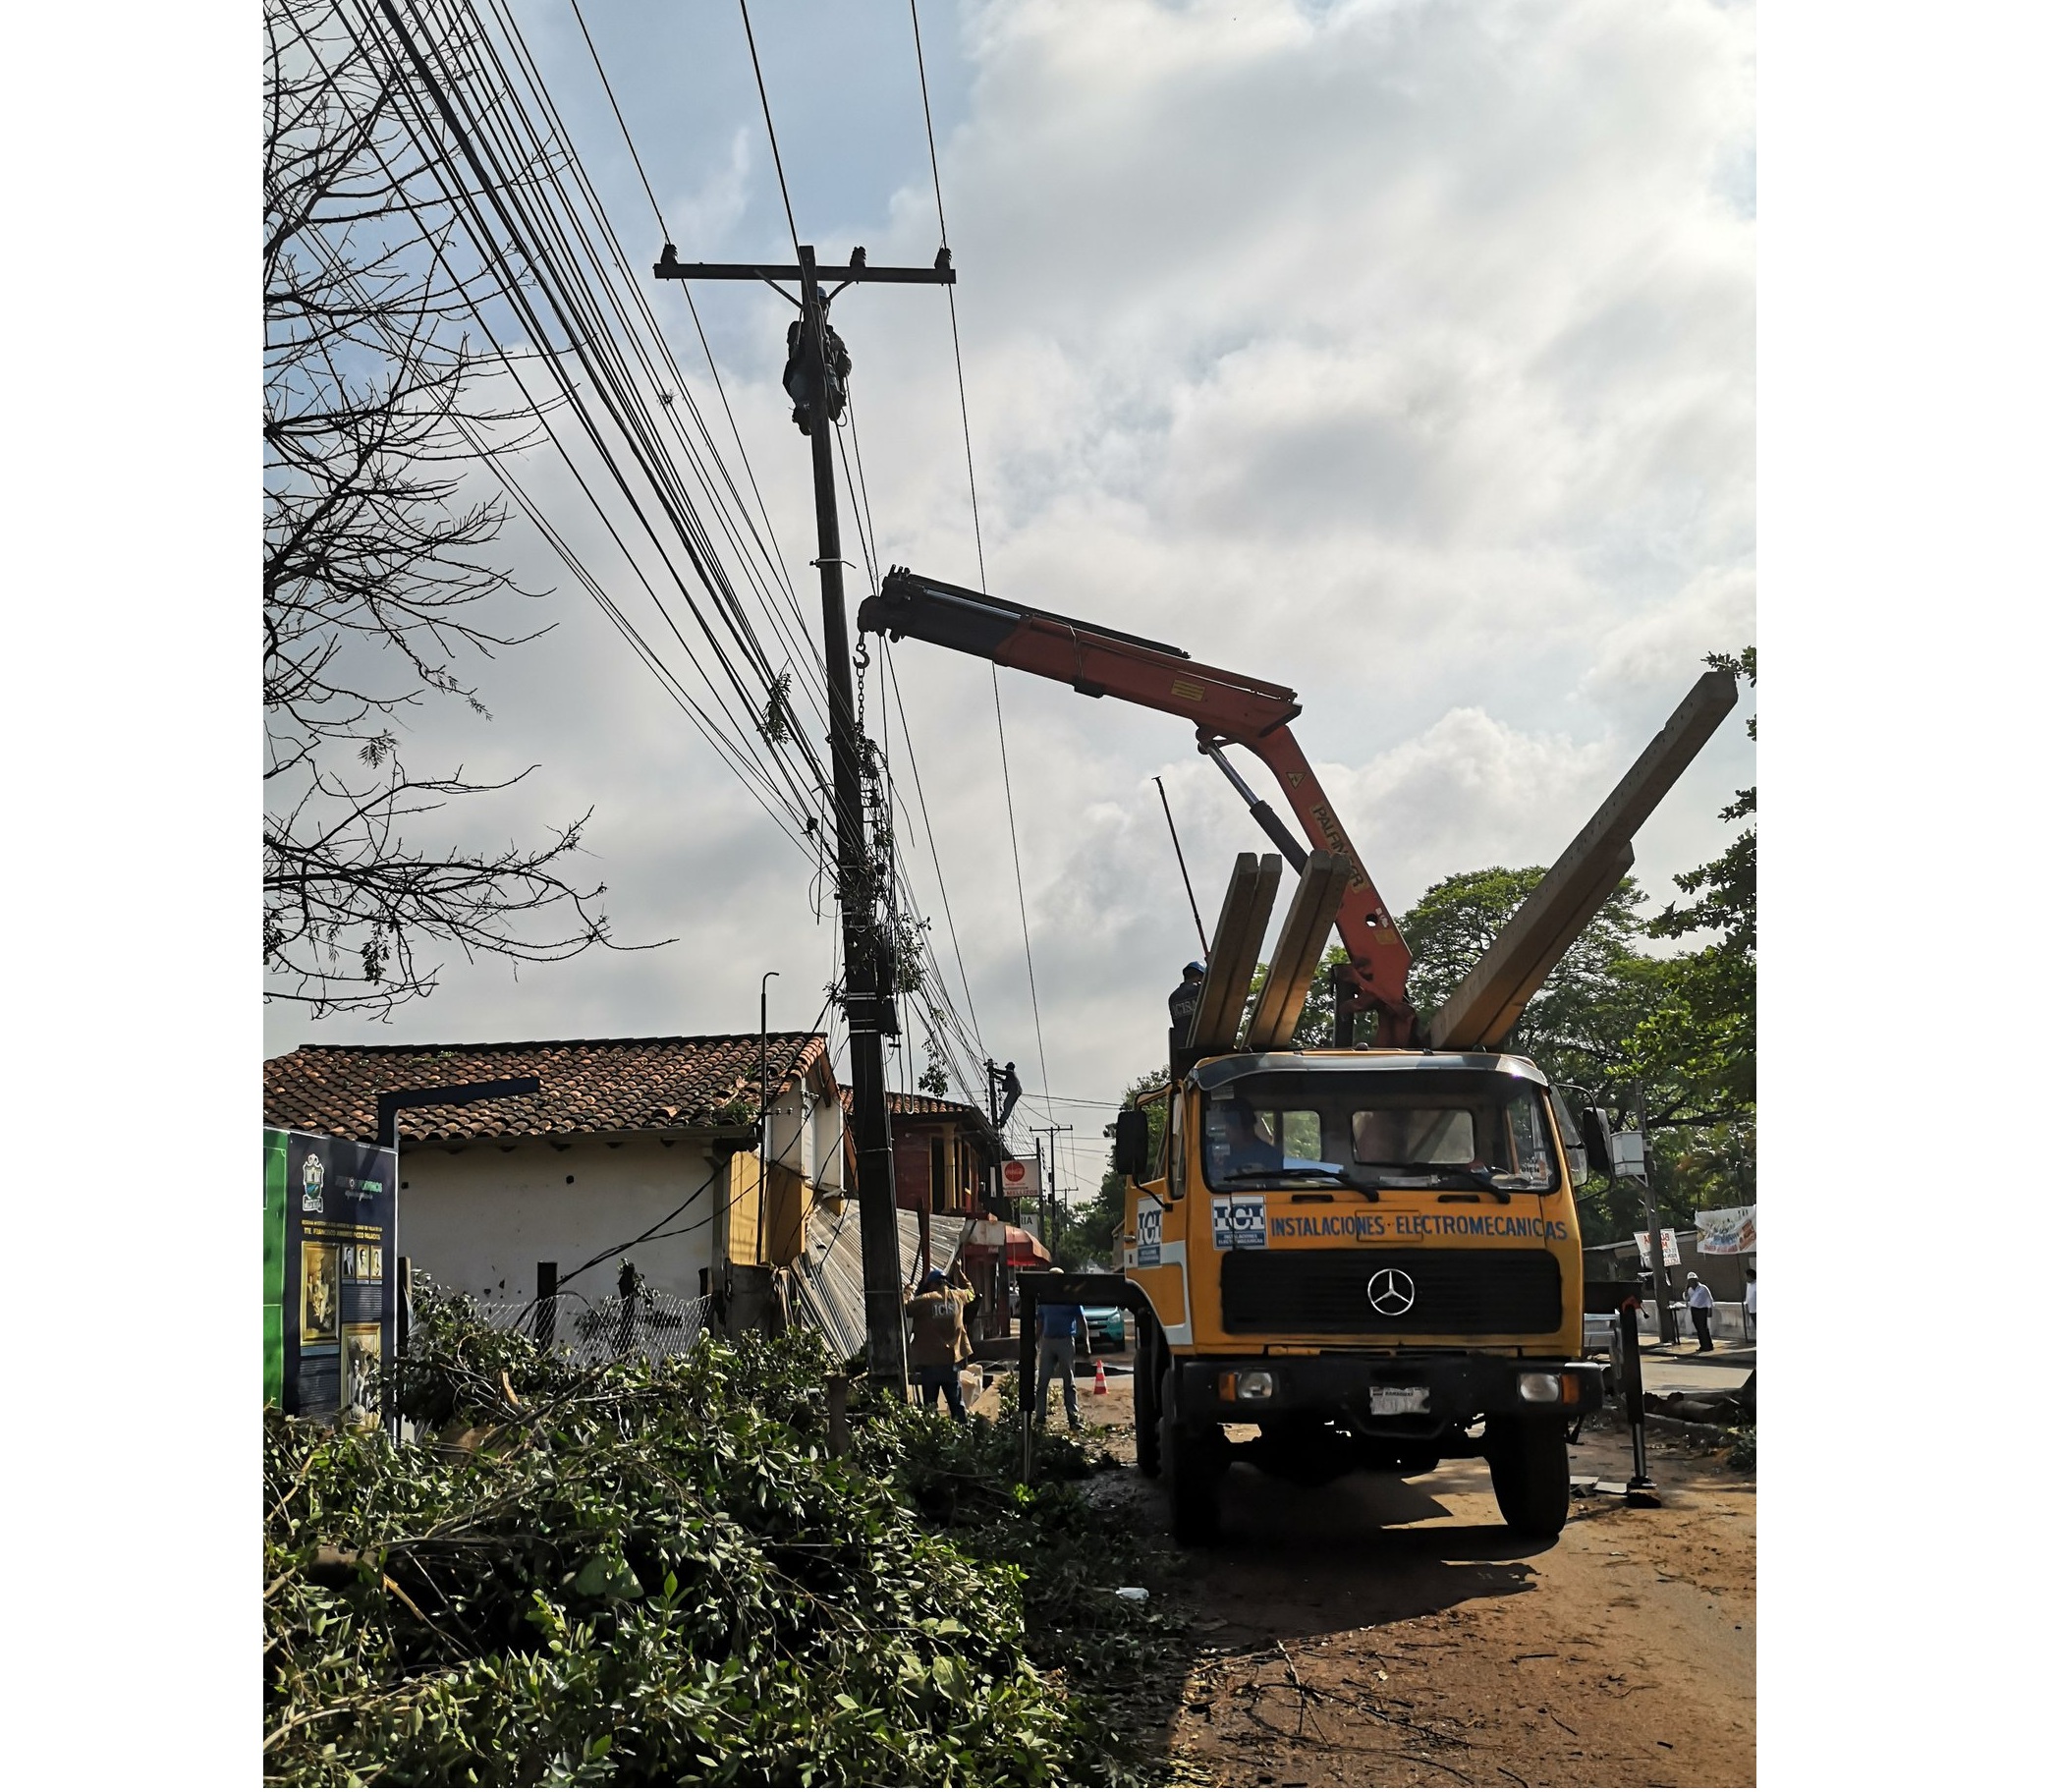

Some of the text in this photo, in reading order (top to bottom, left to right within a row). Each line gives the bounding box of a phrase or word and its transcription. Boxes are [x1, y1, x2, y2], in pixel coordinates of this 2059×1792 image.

[1312, 805, 1363, 888] PALFINER
[1138, 1210, 1161, 1245] ICI
[1214, 1204, 1265, 1231] ICI
[1270, 1214, 1568, 1241] INSTALACIONES ELECTROMECANICAS
